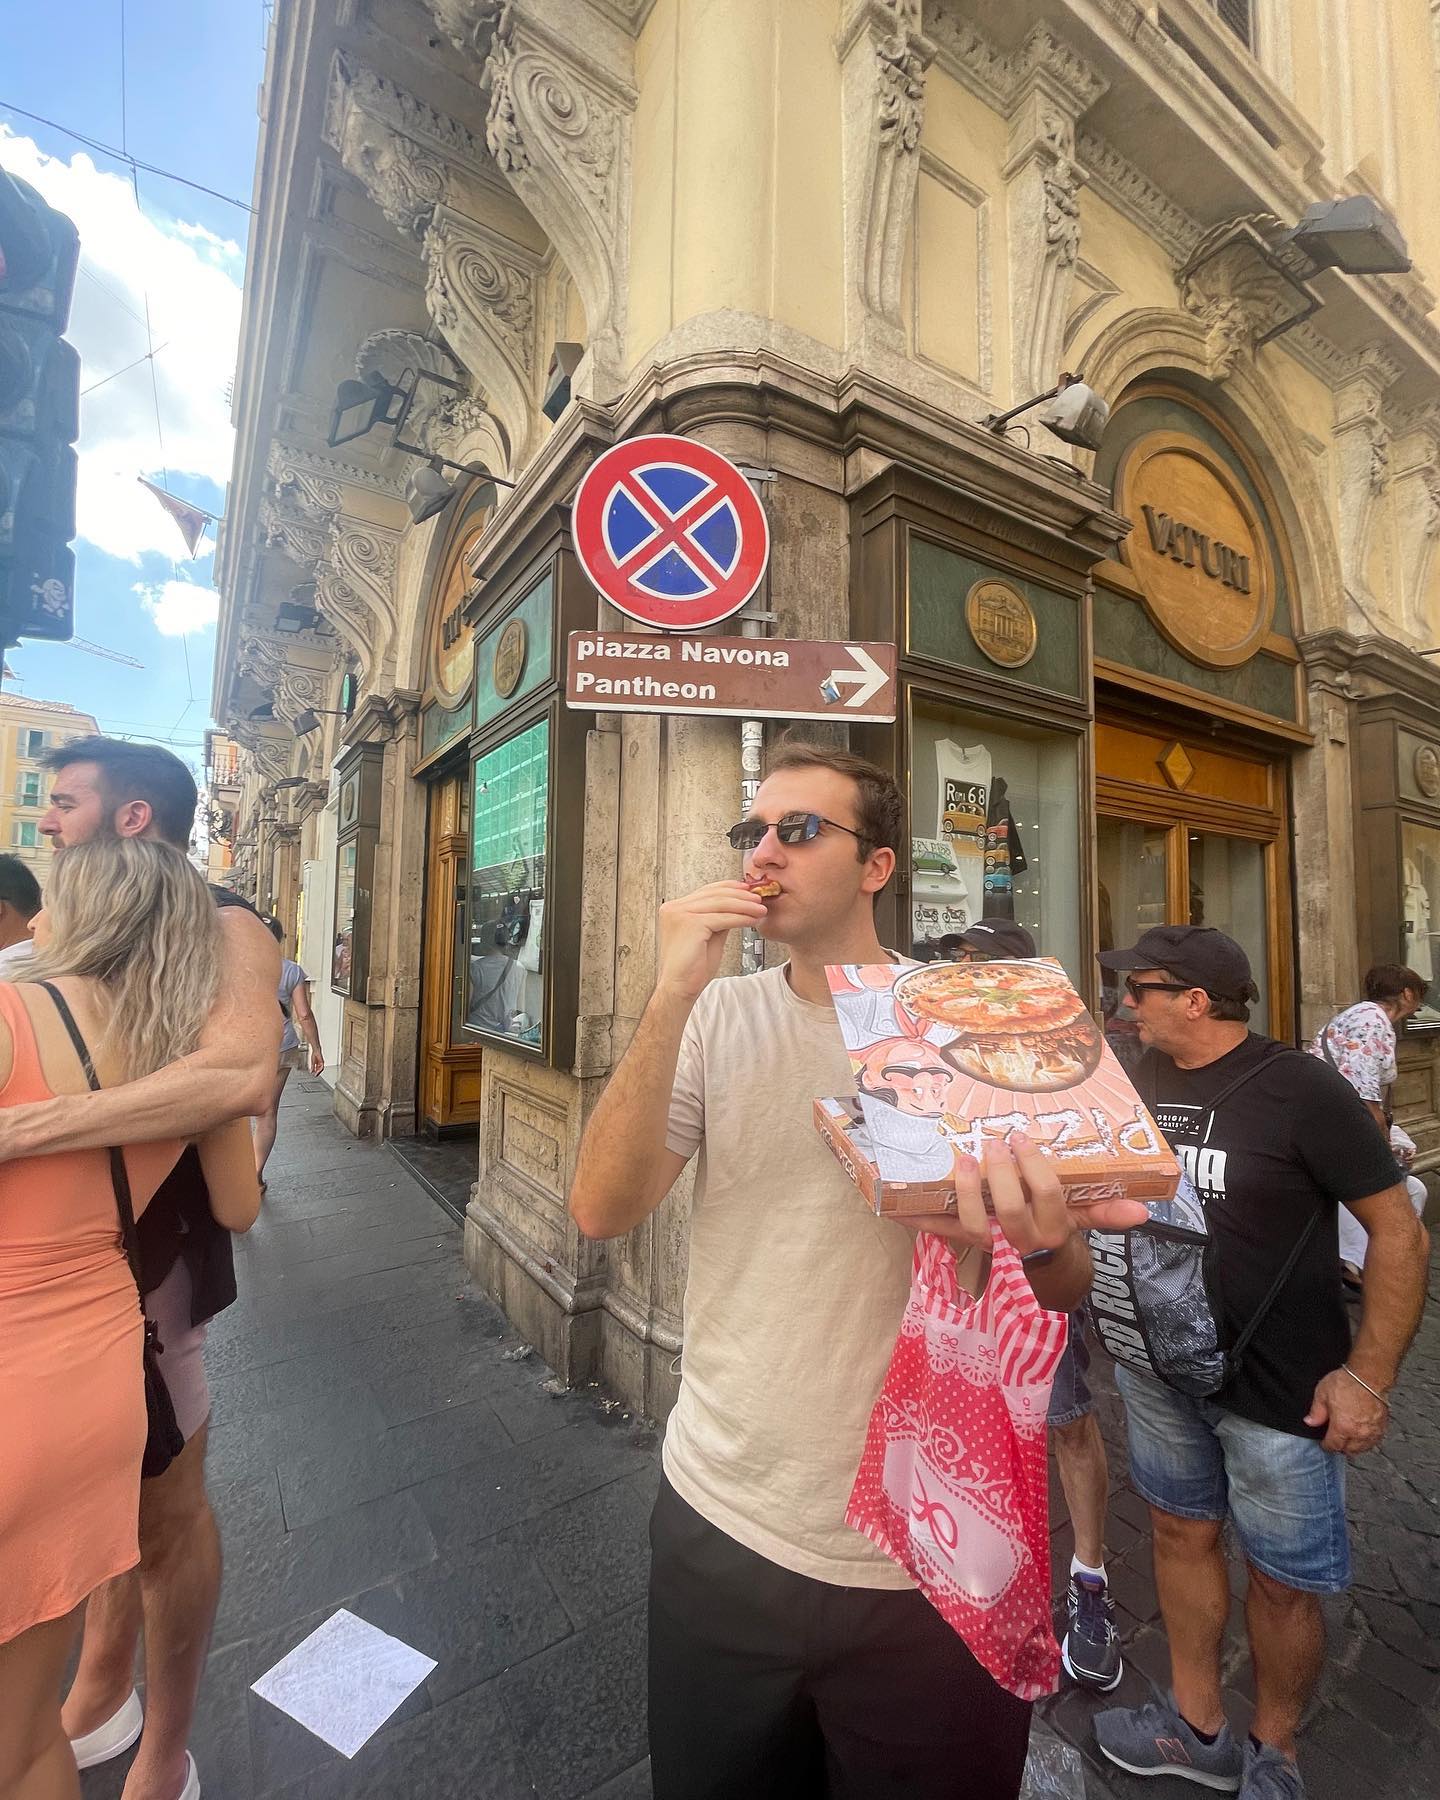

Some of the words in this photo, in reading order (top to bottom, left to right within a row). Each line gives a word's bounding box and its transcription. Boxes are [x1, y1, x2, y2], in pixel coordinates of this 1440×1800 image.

[1140, 504, 1250, 595] VATURI
[577, 637, 671, 661] piazza
[681, 641, 789, 667] Navona
[576, 673, 716, 700] Pantheon
[968, 786, 986, 806] 68
